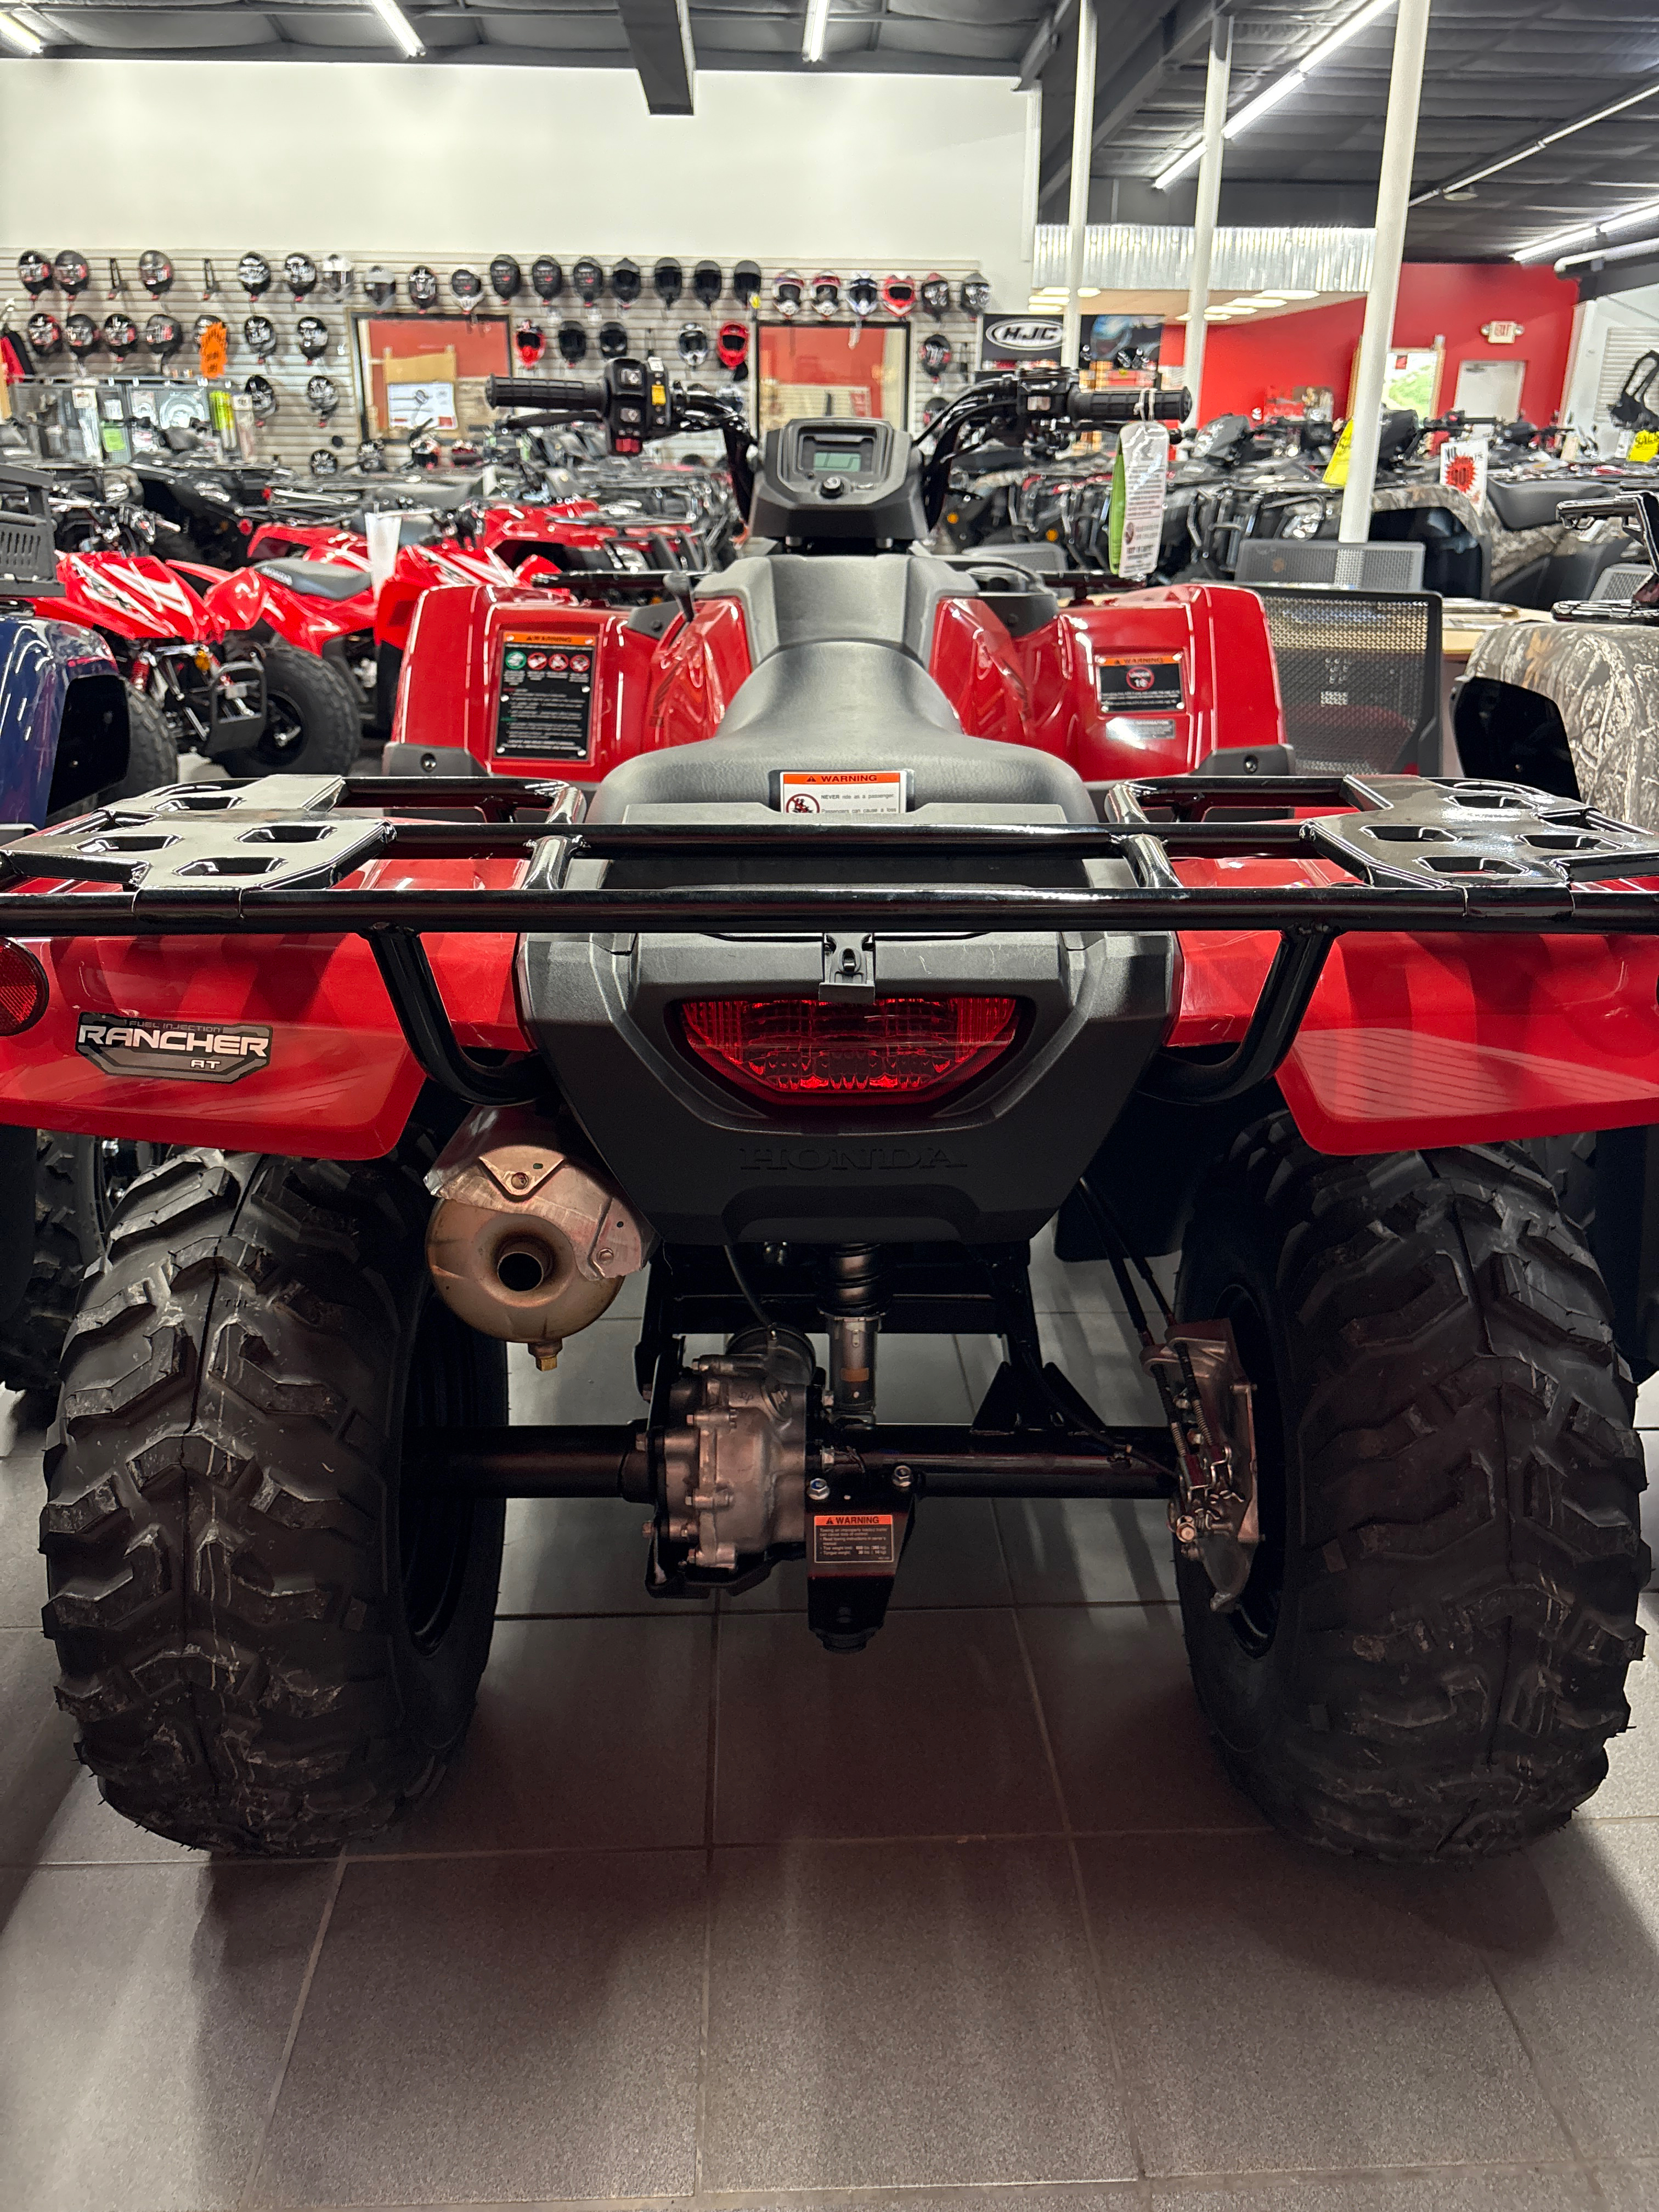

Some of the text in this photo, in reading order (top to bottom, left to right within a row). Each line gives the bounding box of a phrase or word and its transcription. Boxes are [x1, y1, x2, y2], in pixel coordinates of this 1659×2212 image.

[1003, 326, 1058, 340] HJC
[128, 1020, 222, 1032] FUEL INJECTION
[78, 1024, 269, 1057] RANCHER
[190, 1059, 221, 1069] AT
[739, 1147, 968, 1171] HONDA
[836, 1516, 879, 1524] WARNING
